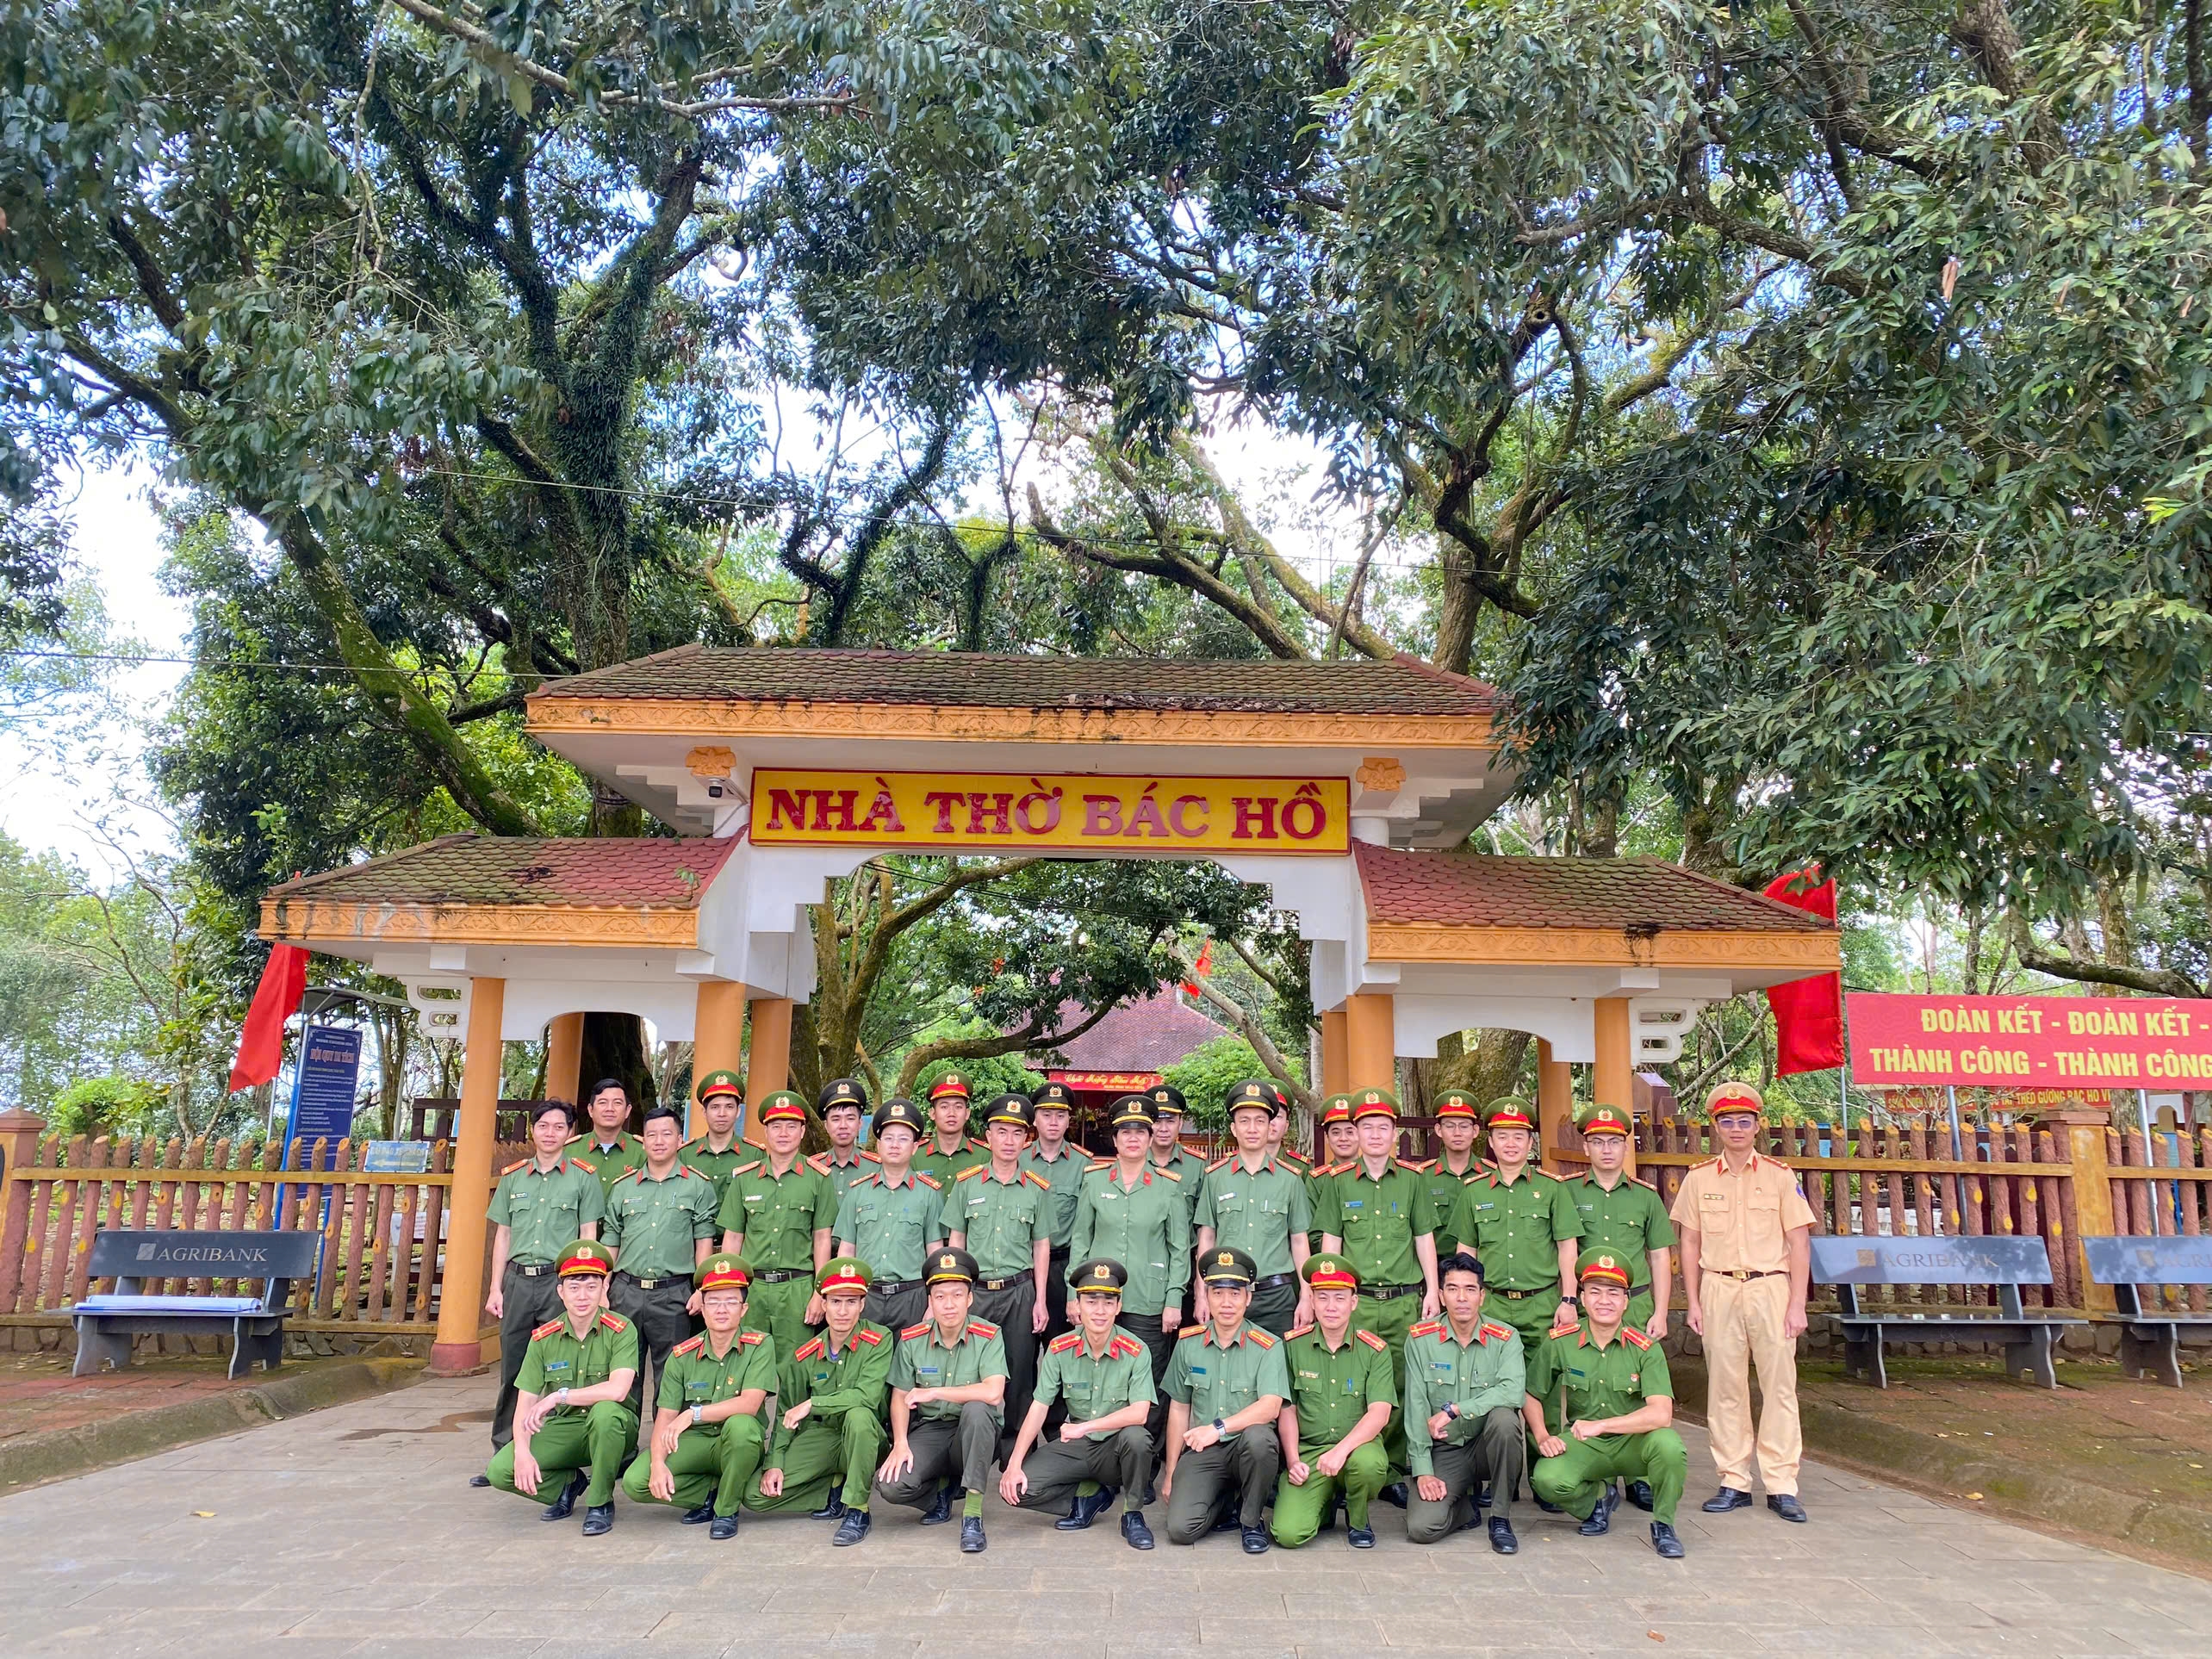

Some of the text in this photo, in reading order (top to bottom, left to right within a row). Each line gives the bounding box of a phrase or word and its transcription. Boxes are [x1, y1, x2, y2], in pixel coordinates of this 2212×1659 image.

[766, 776, 1327, 840] NHÀ THỜ BÁC HỒ
[1921, 1004, 1991, 1033] ĐOÀN
[1997, 1003, 2043, 1034] KẾT
[2067, 1007, 2139, 1035] ĐOÀN
[2145, 1005, 2191, 1036] KẾT
[1869, 1043, 1953, 1073] THÀNH
[1960, 1045, 2030, 1075] CÔNG
[2053, 1047, 2140, 1077] THÀNH
[2146, 1048, 2212, 1078] CÔNG
[157, 1247, 269, 1262] AGRIBANK
